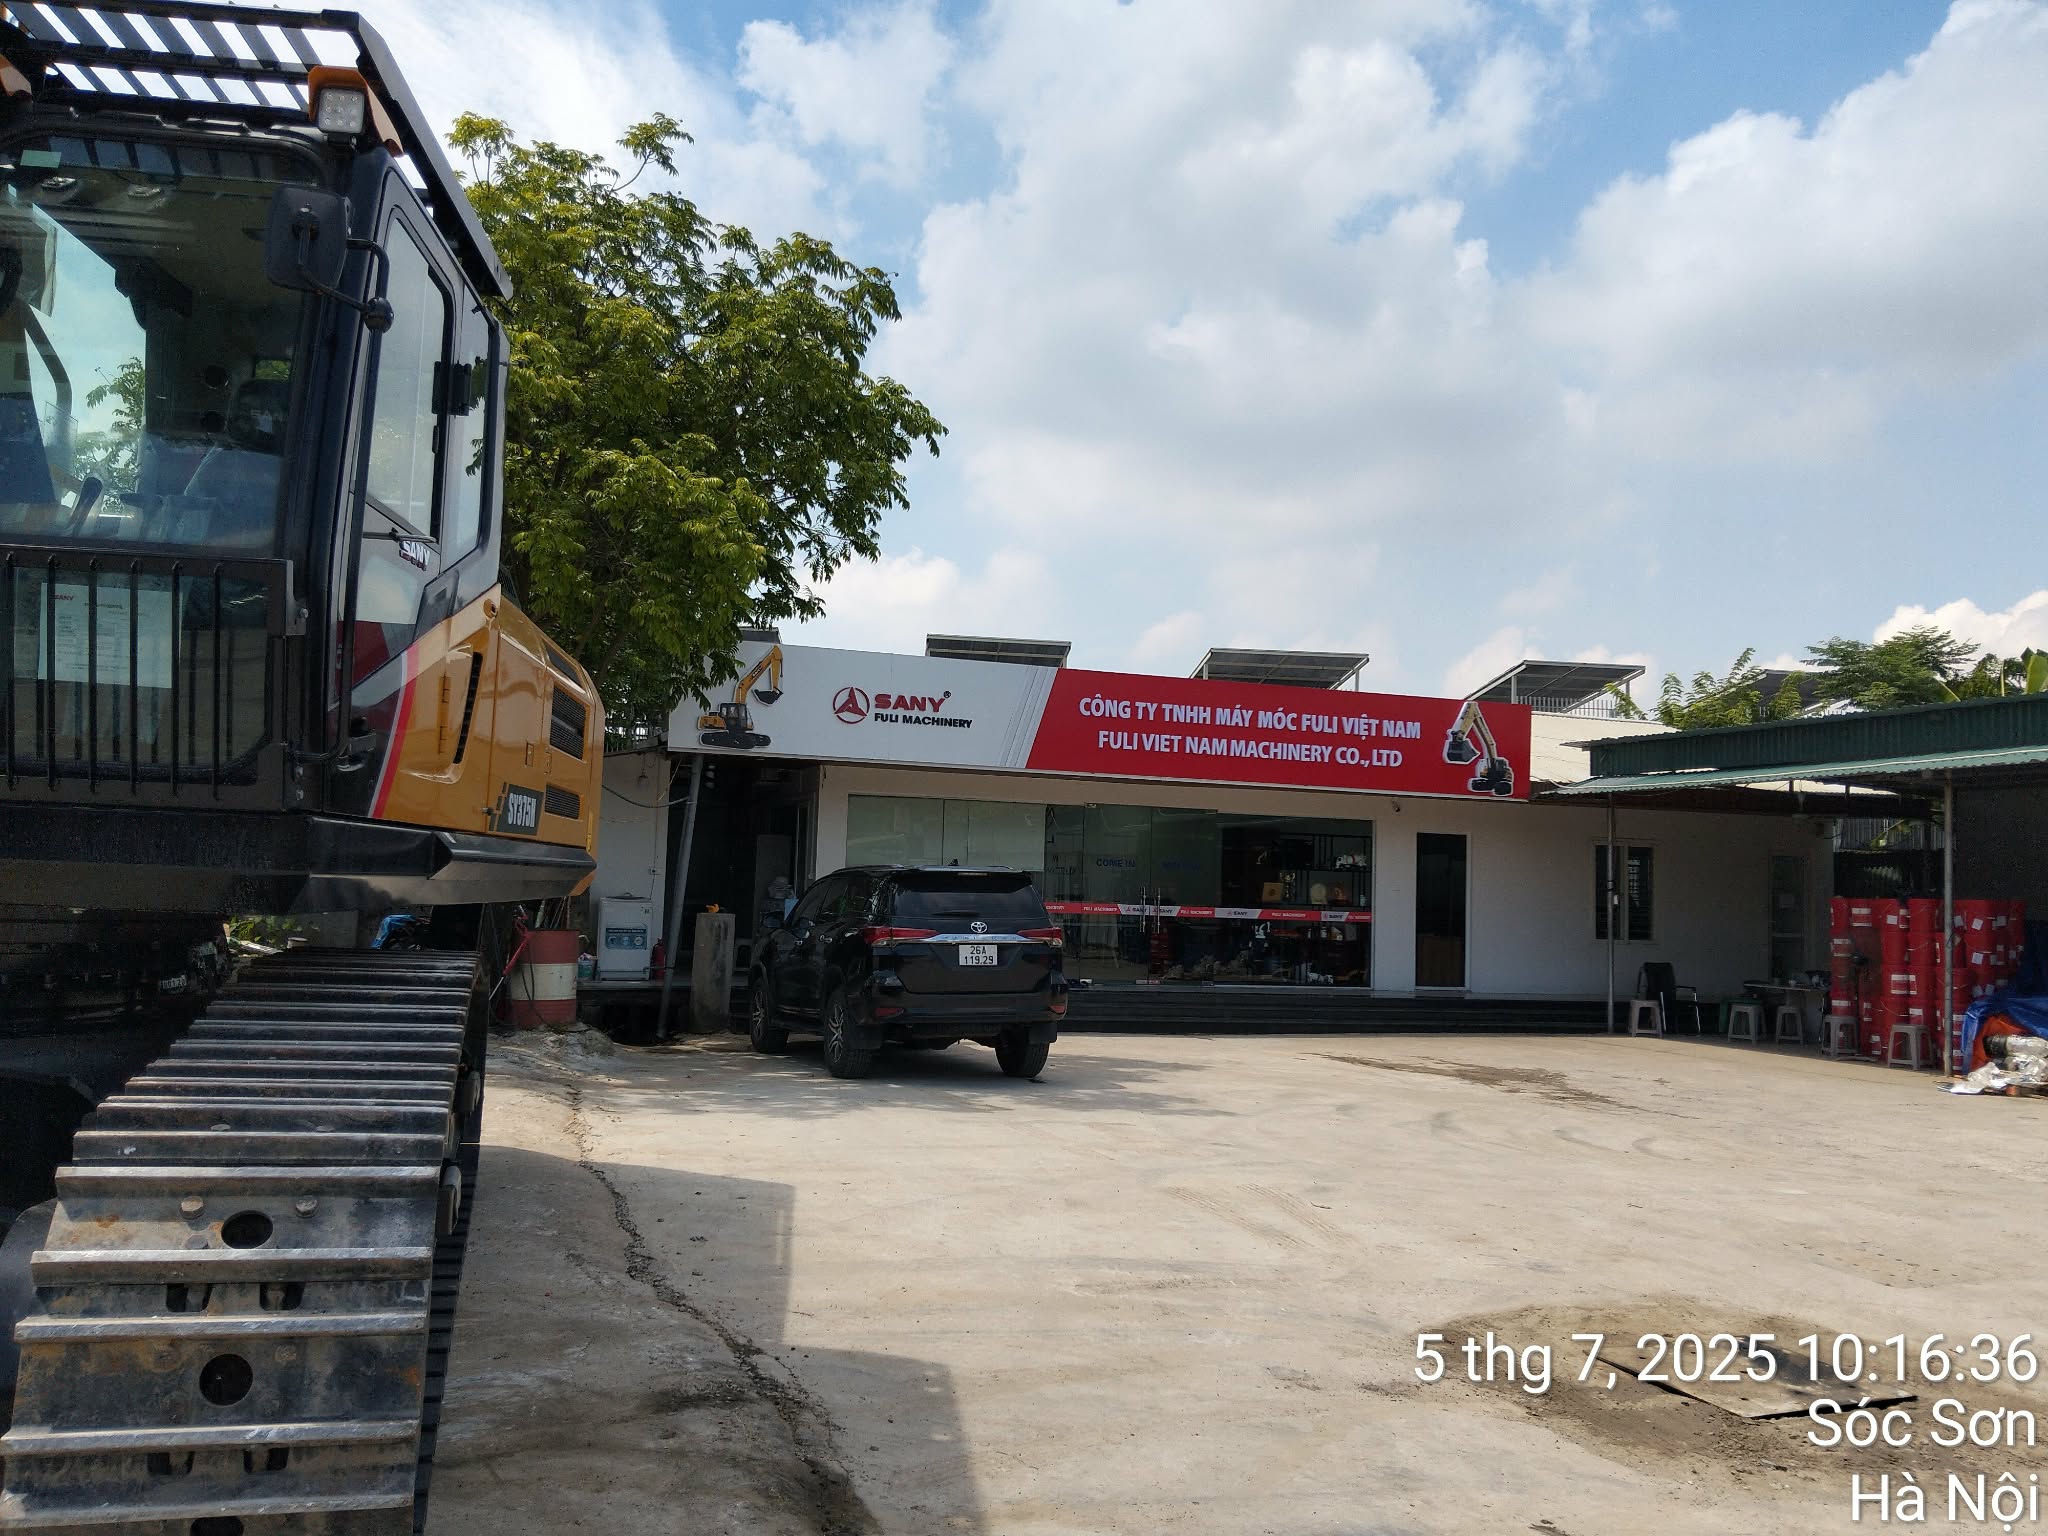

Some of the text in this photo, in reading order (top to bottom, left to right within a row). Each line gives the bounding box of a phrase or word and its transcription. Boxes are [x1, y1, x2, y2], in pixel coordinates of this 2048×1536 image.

[401, 540, 430, 566] SANY
[874, 712, 973, 729] FULI MACHINERY
[1079, 693, 1421, 741] CÔNG TY TNHH MÁY MÓC FULI VIỆT NAM
[1098, 730, 1138, 750] FULI
[1142, 733, 1182, 753] VIET
[1185, 736, 1227, 756] NAM
[1229, 739, 1333, 763] MACHINERY
[964, 956, 994, 965] 119.29
[970, 945, 987, 955] 26A
